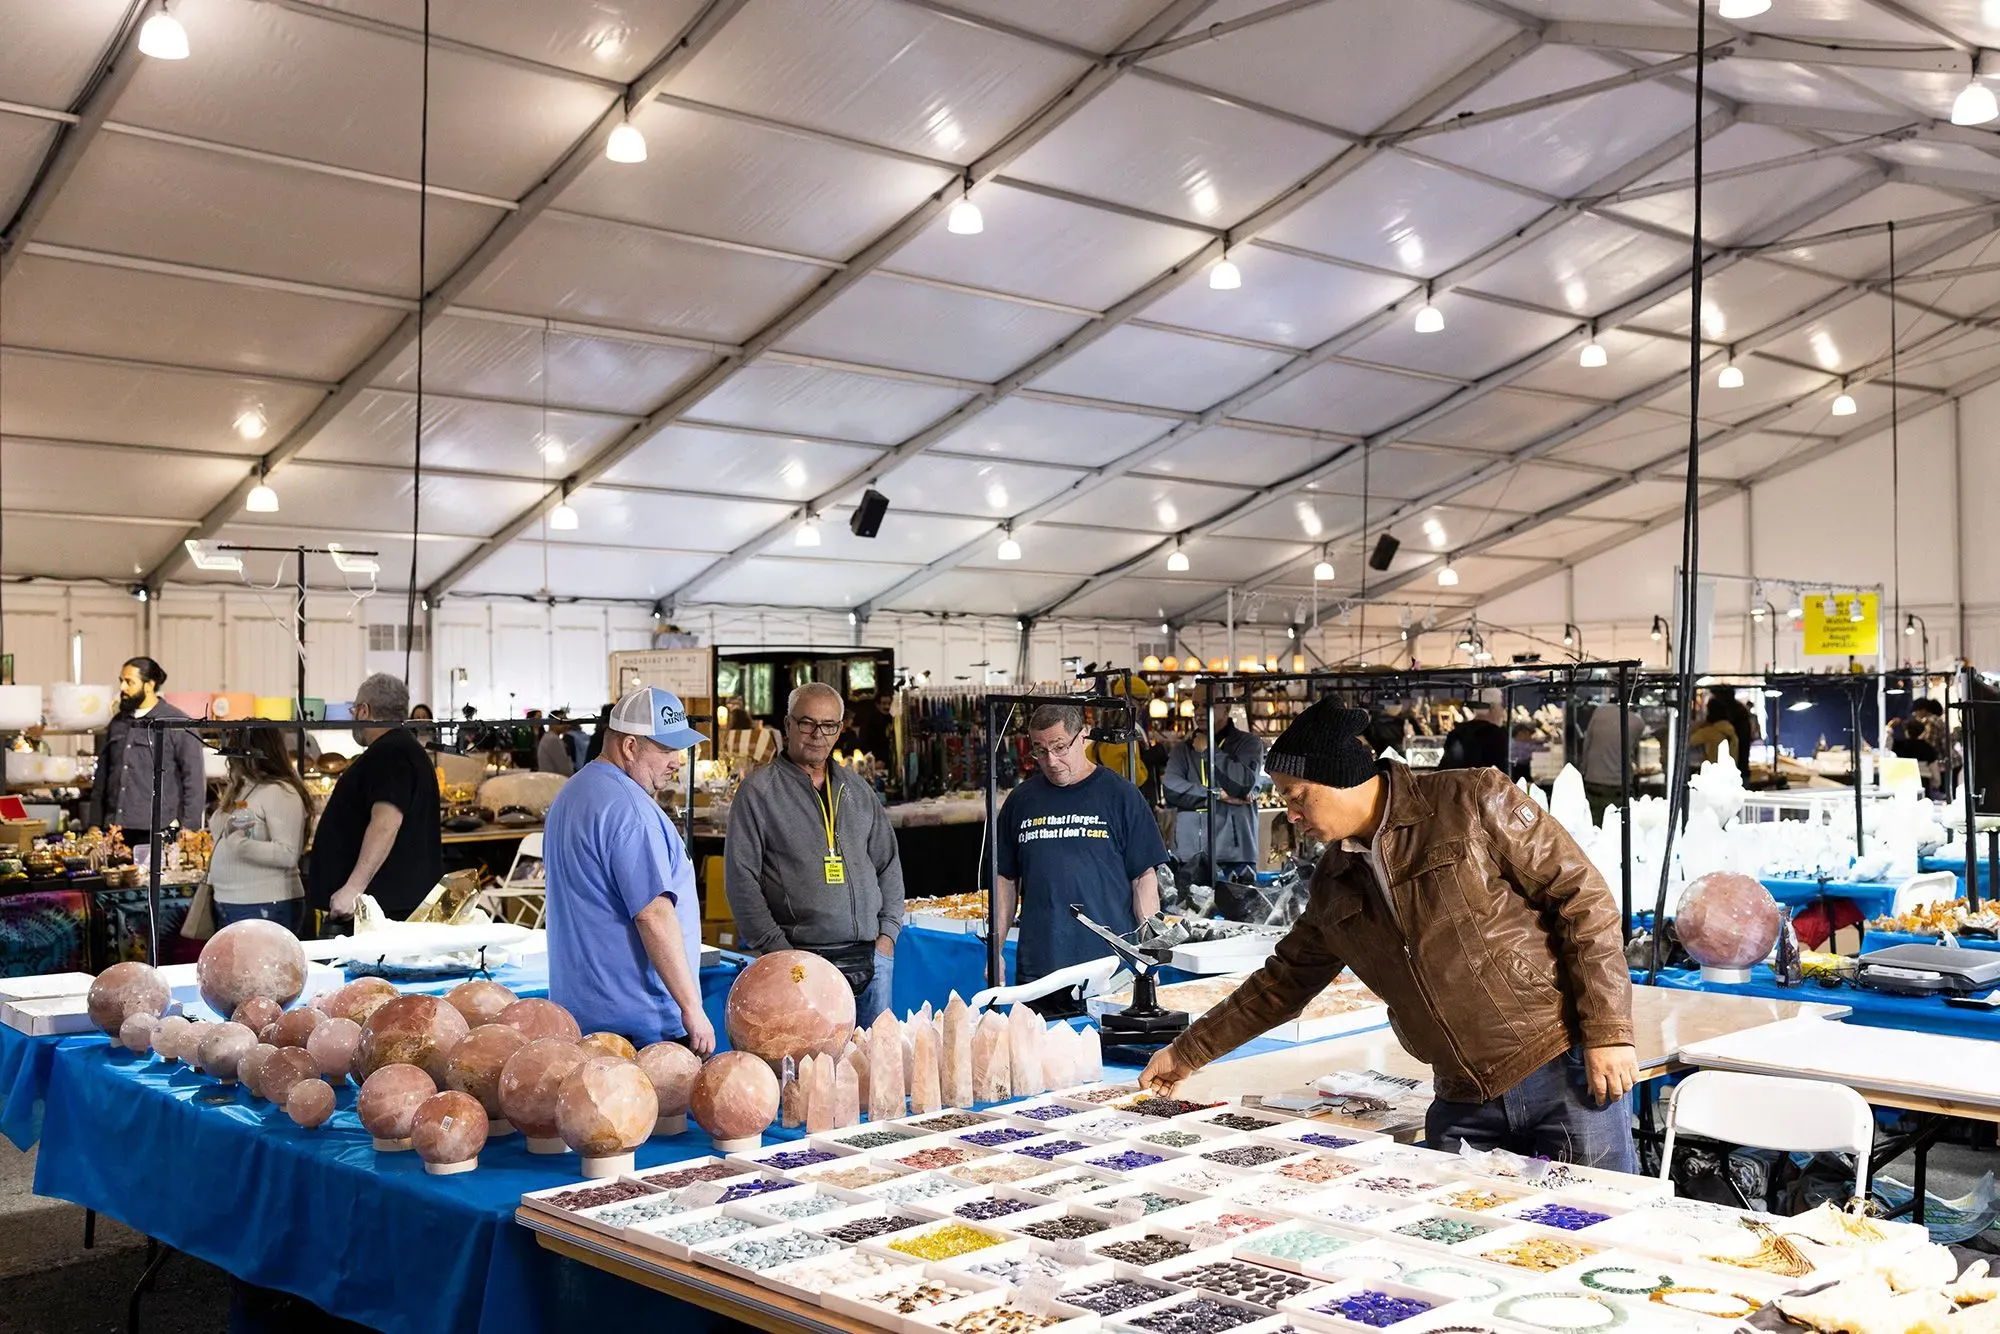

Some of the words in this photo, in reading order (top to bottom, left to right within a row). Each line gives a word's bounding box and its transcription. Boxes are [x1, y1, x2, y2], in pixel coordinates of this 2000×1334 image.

[1032, 816, 1046, 827] not
[1047, 815, 1066, 825] that
[1066, 814, 1071, 824] I
[1071, 814, 1107, 825] forget...
[1025, 829, 1039, 843] just
[1040, 828, 1058, 839] that
[1063, 827, 1087, 838] don't
[1087, 829, 1110, 839] care.
